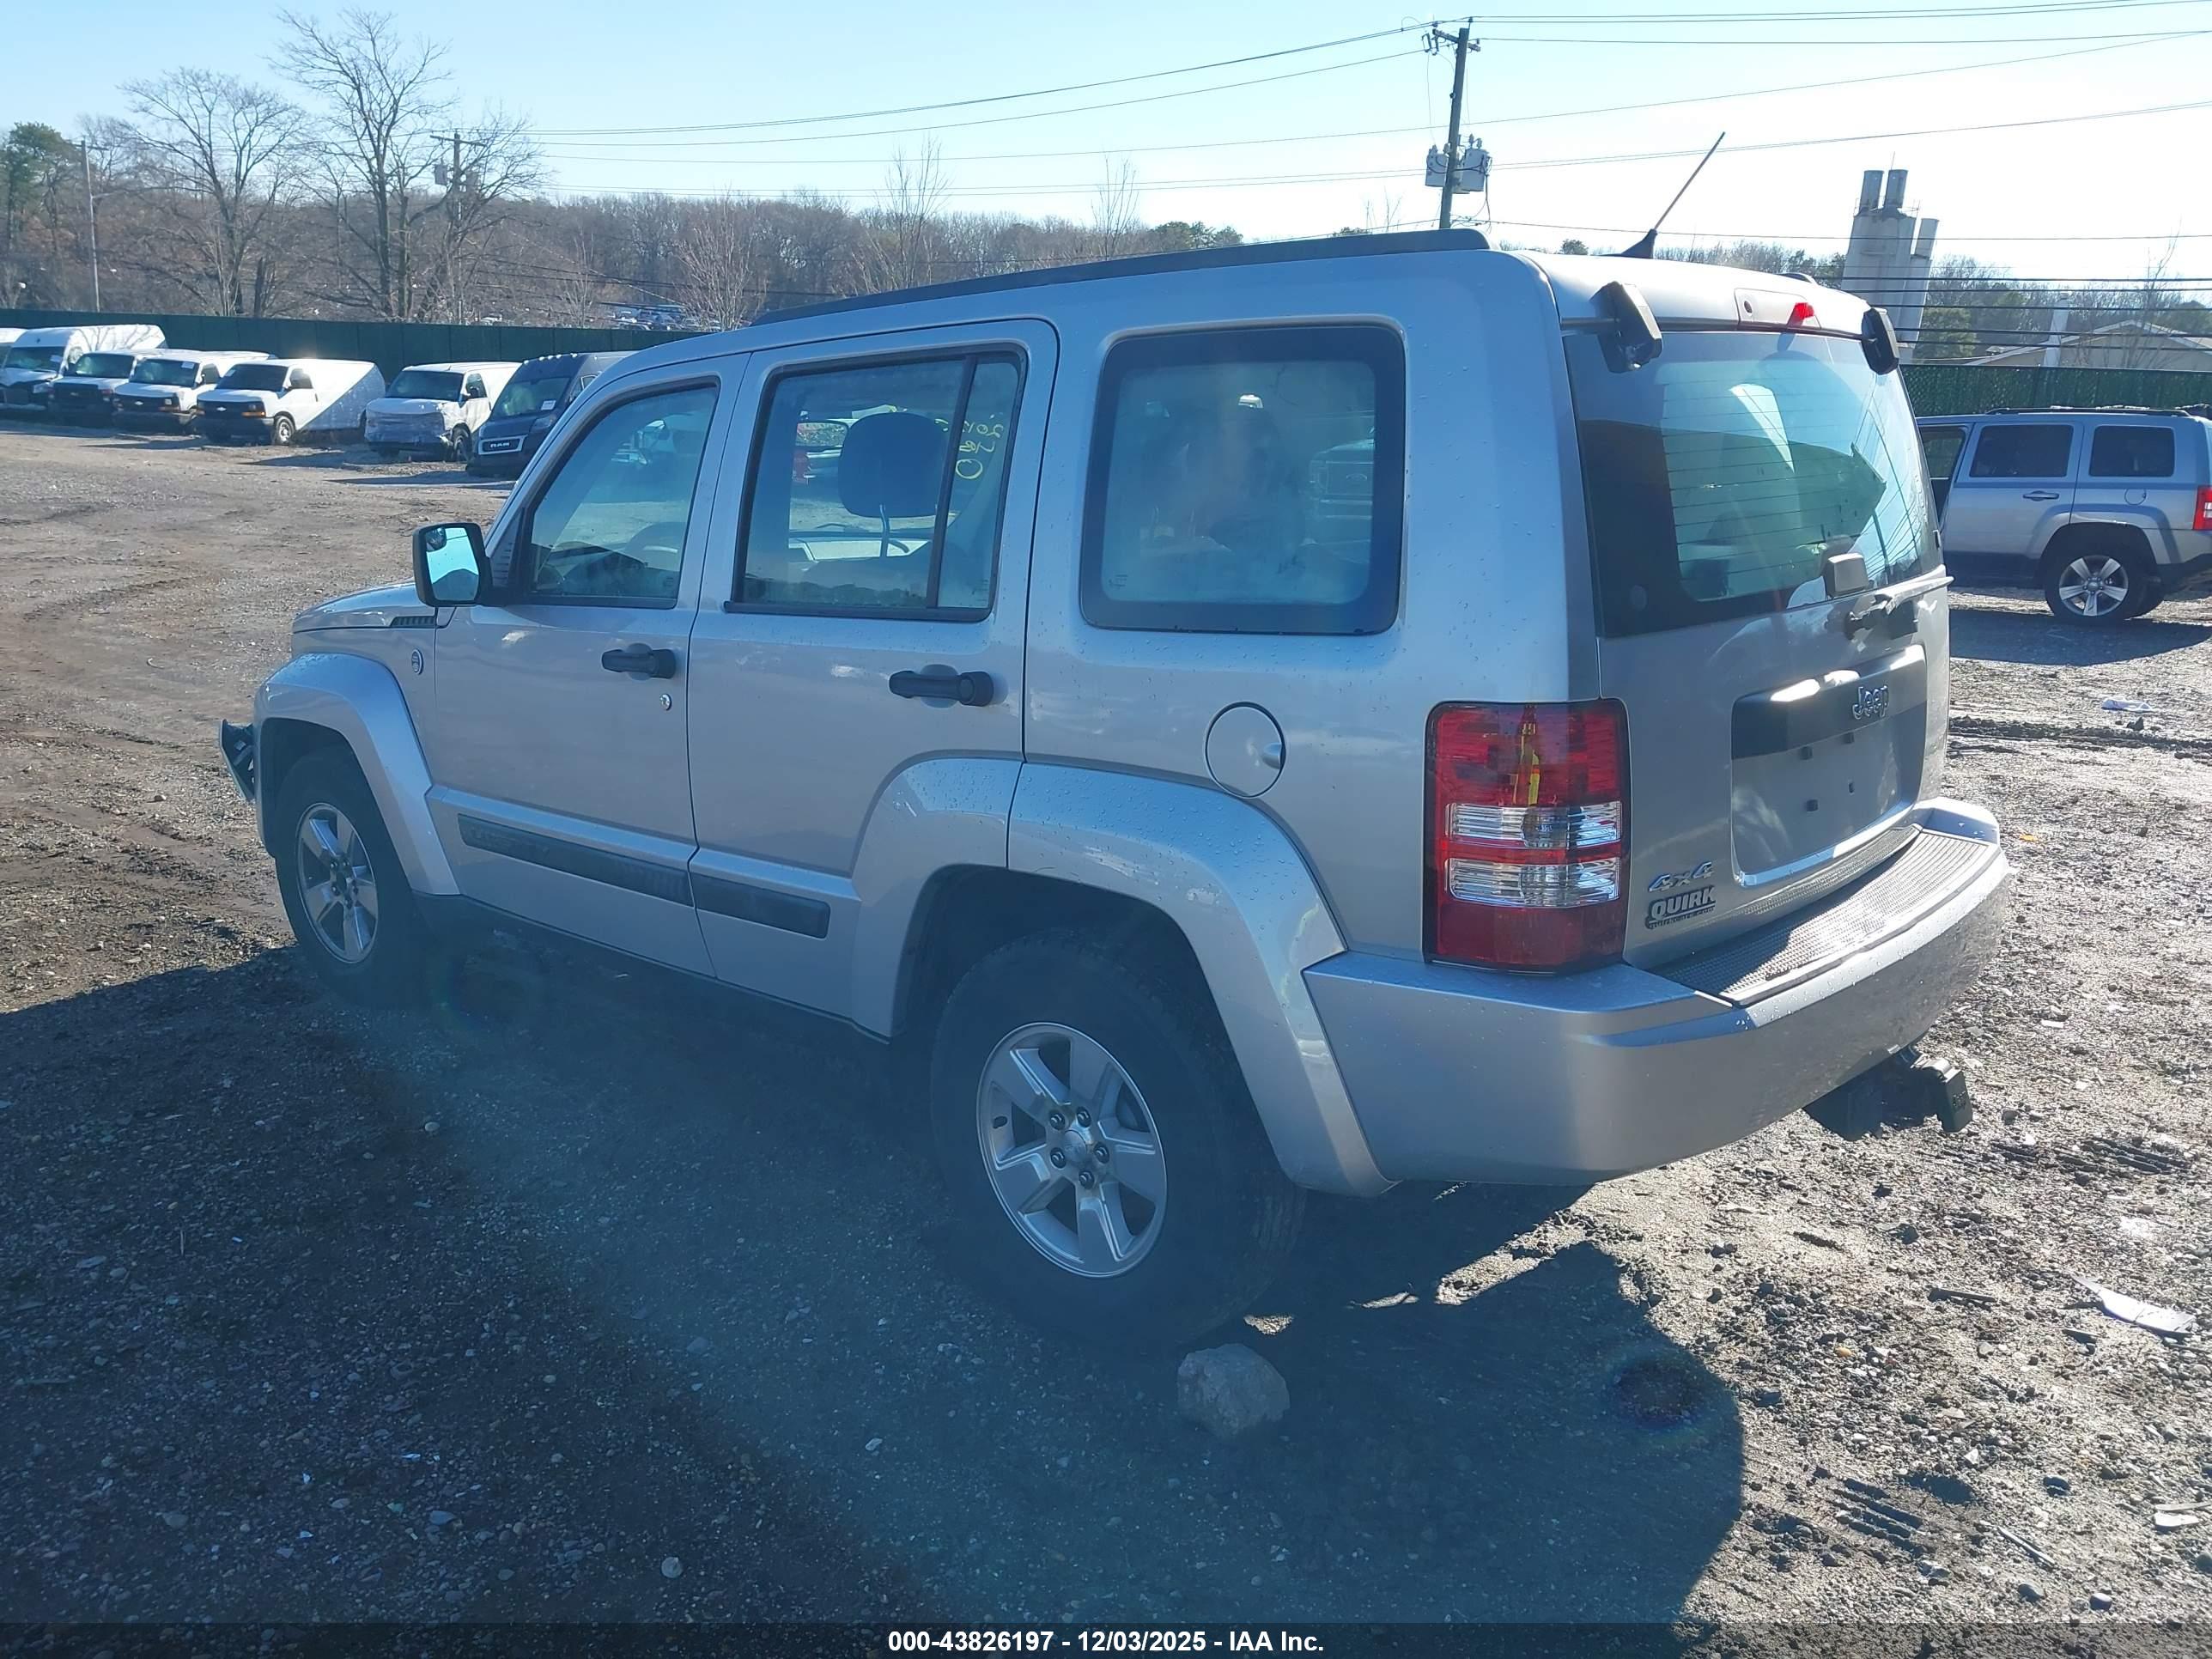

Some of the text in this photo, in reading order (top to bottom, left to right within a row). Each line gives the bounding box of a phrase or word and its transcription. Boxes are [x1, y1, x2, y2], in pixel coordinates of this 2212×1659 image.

[1852, 684, 1889, 720] Jeep
[1648, 861, 1714, 892] 4x4
[1650, 885, 1716, 921] QUIRK
